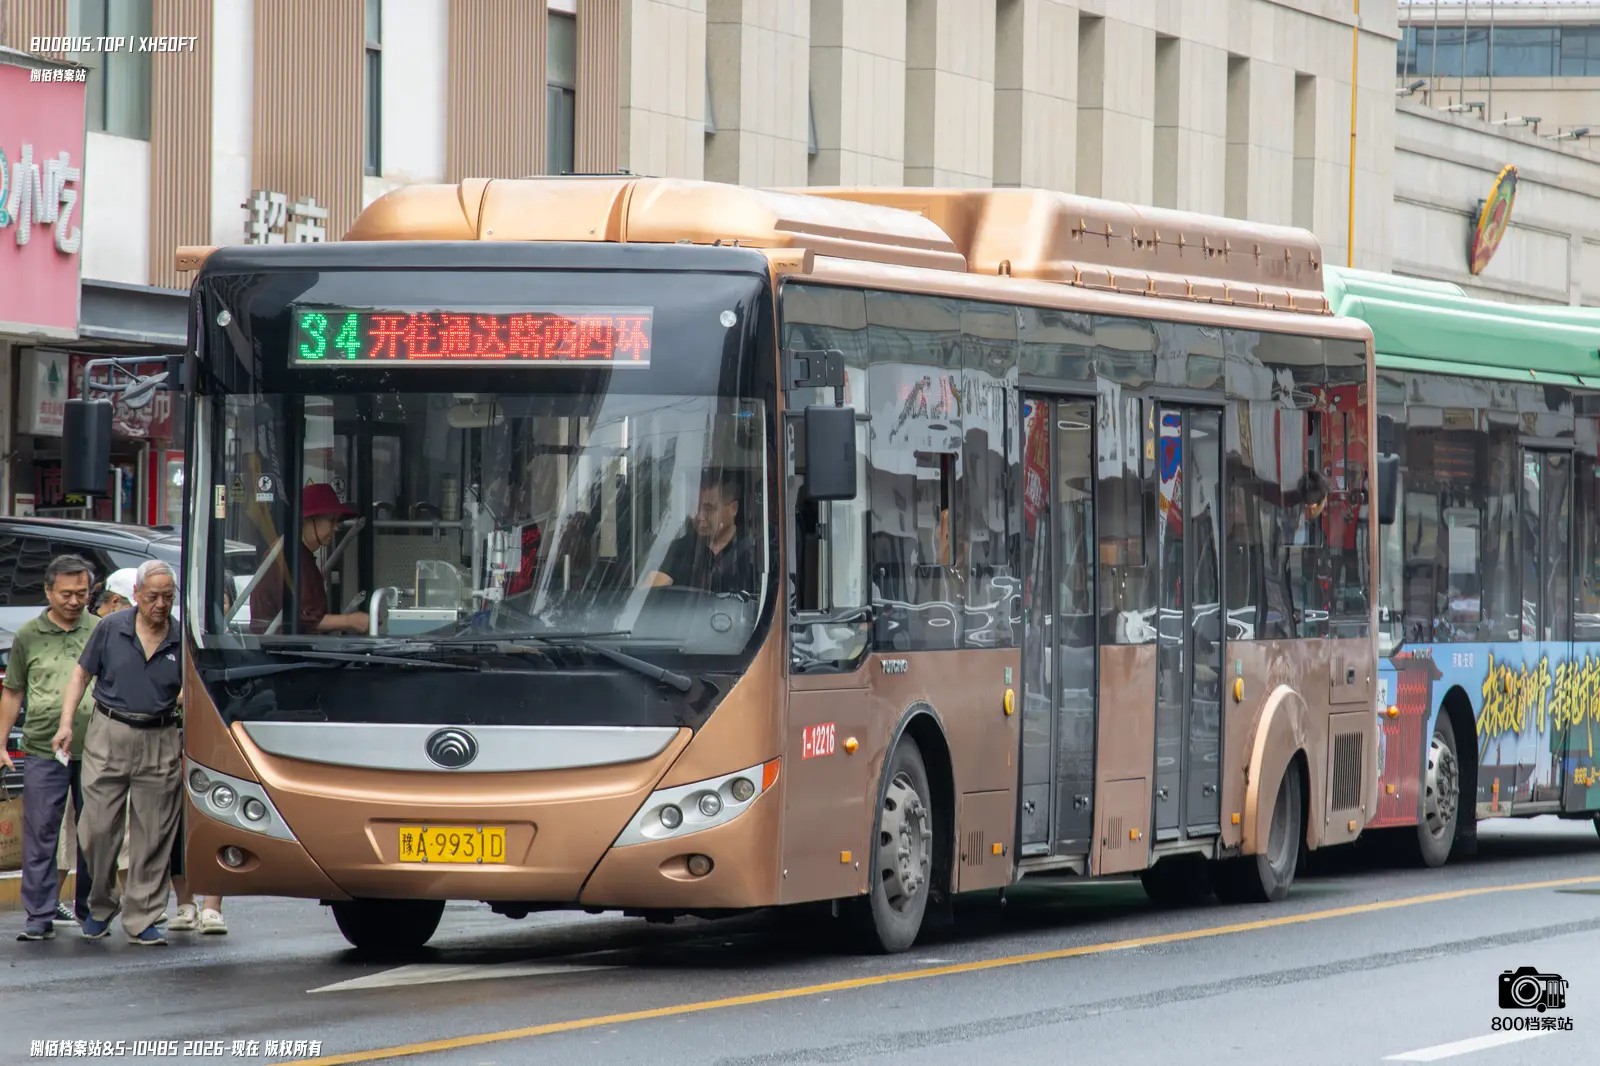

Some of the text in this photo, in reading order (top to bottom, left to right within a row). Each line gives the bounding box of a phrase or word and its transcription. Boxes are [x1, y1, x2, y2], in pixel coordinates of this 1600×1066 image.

[8, 143, 81, 254] 小吃
[300, 313, 360, 360] 34
[803, 723, 835, 758] 1-12216
